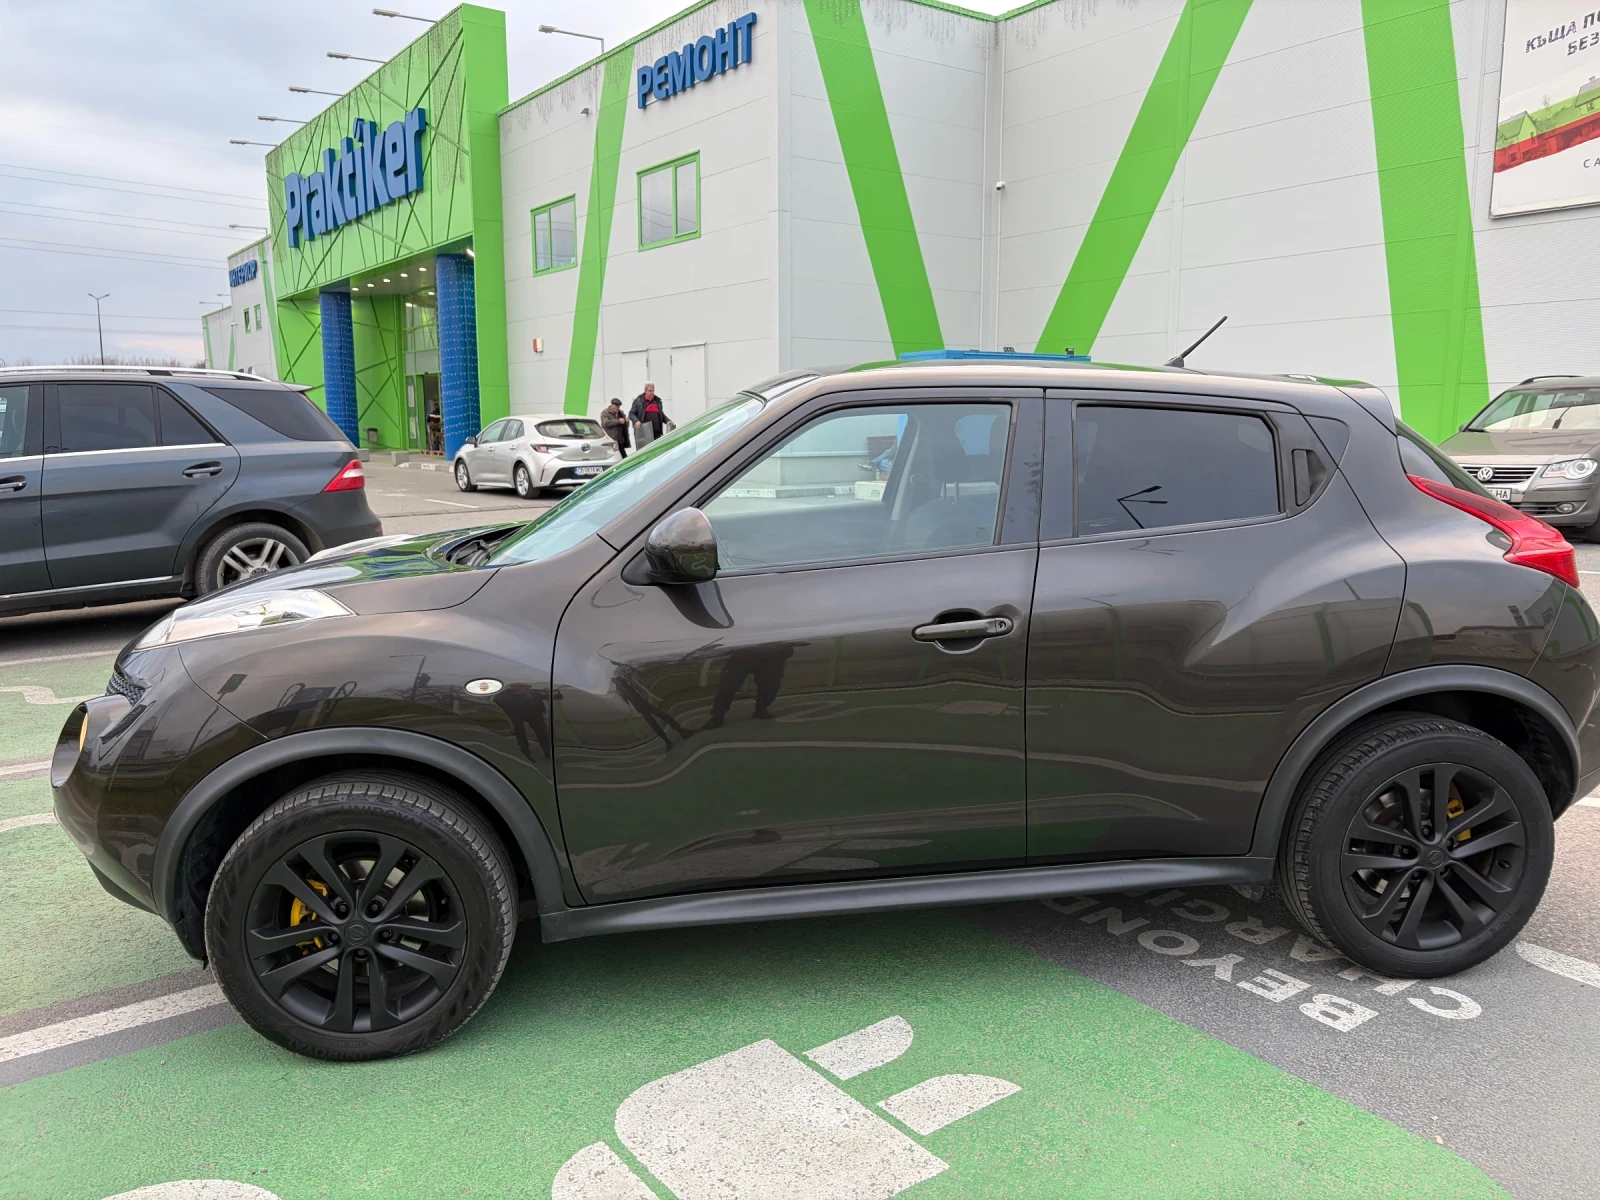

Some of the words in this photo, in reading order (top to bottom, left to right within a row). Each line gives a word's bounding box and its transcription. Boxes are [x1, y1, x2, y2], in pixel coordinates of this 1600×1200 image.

[636, 12, 757, 110] РЕМОНТ
[1525, 20, 1577, 54] КЪЩА
[1583, 10, 1600, 30] П
[1567, 31, 1600, 56] БЕЗ
[284, 107, 427, 249] Praktiker
[1039, 894, 1380, 1034] BEYOND
